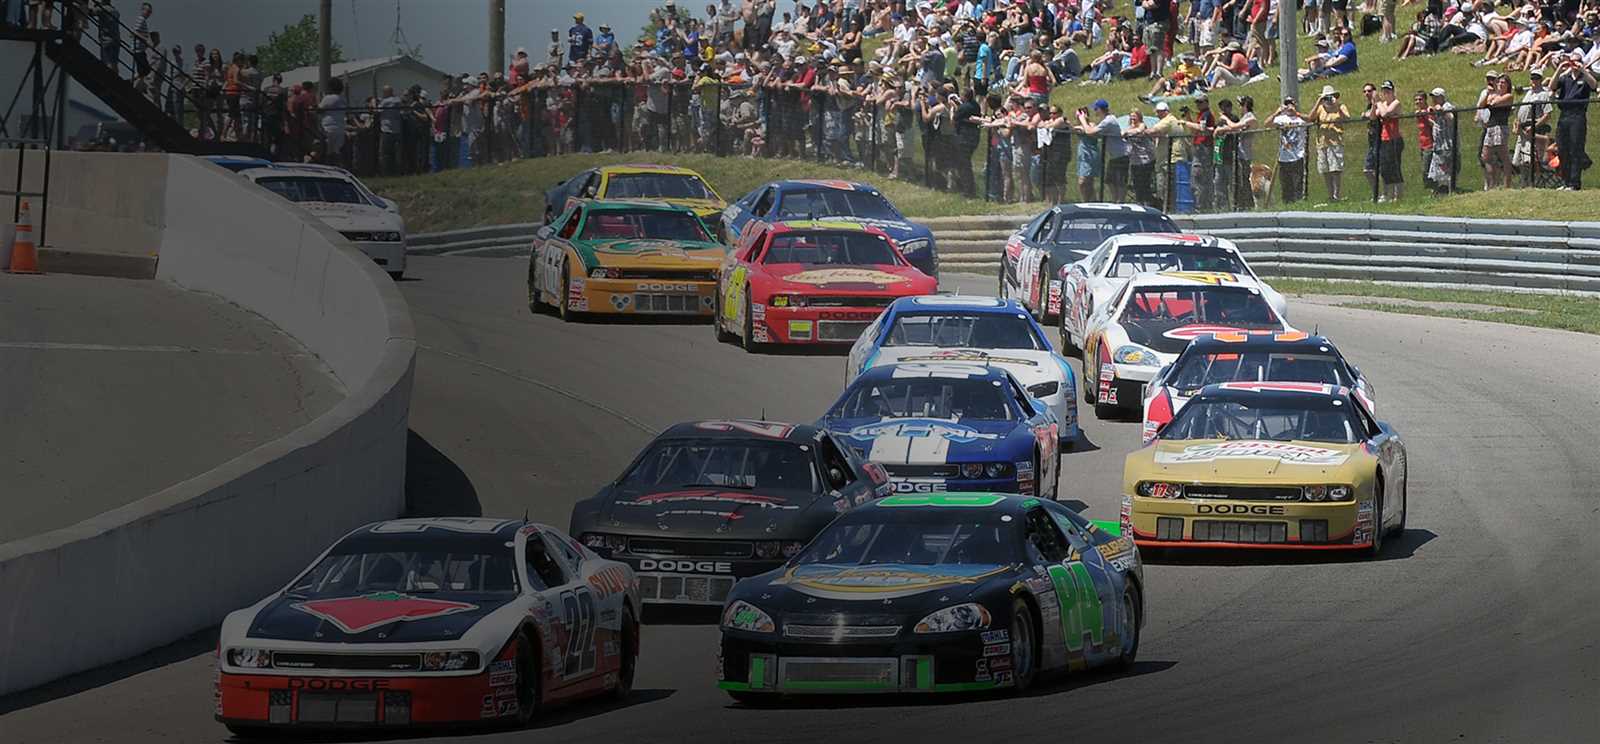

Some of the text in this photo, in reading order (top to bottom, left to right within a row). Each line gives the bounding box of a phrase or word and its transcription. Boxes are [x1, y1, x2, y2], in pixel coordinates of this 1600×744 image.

[637, 283, 698, 292] DODGE
[1196, 504, 1284, 515] DODGE
[639, 559, 733, 573] DODGE
[1047, 560, 1104, 652] 84
[560, 586, 597, 681] 22
[288, 678, 390, 690] DODGE
